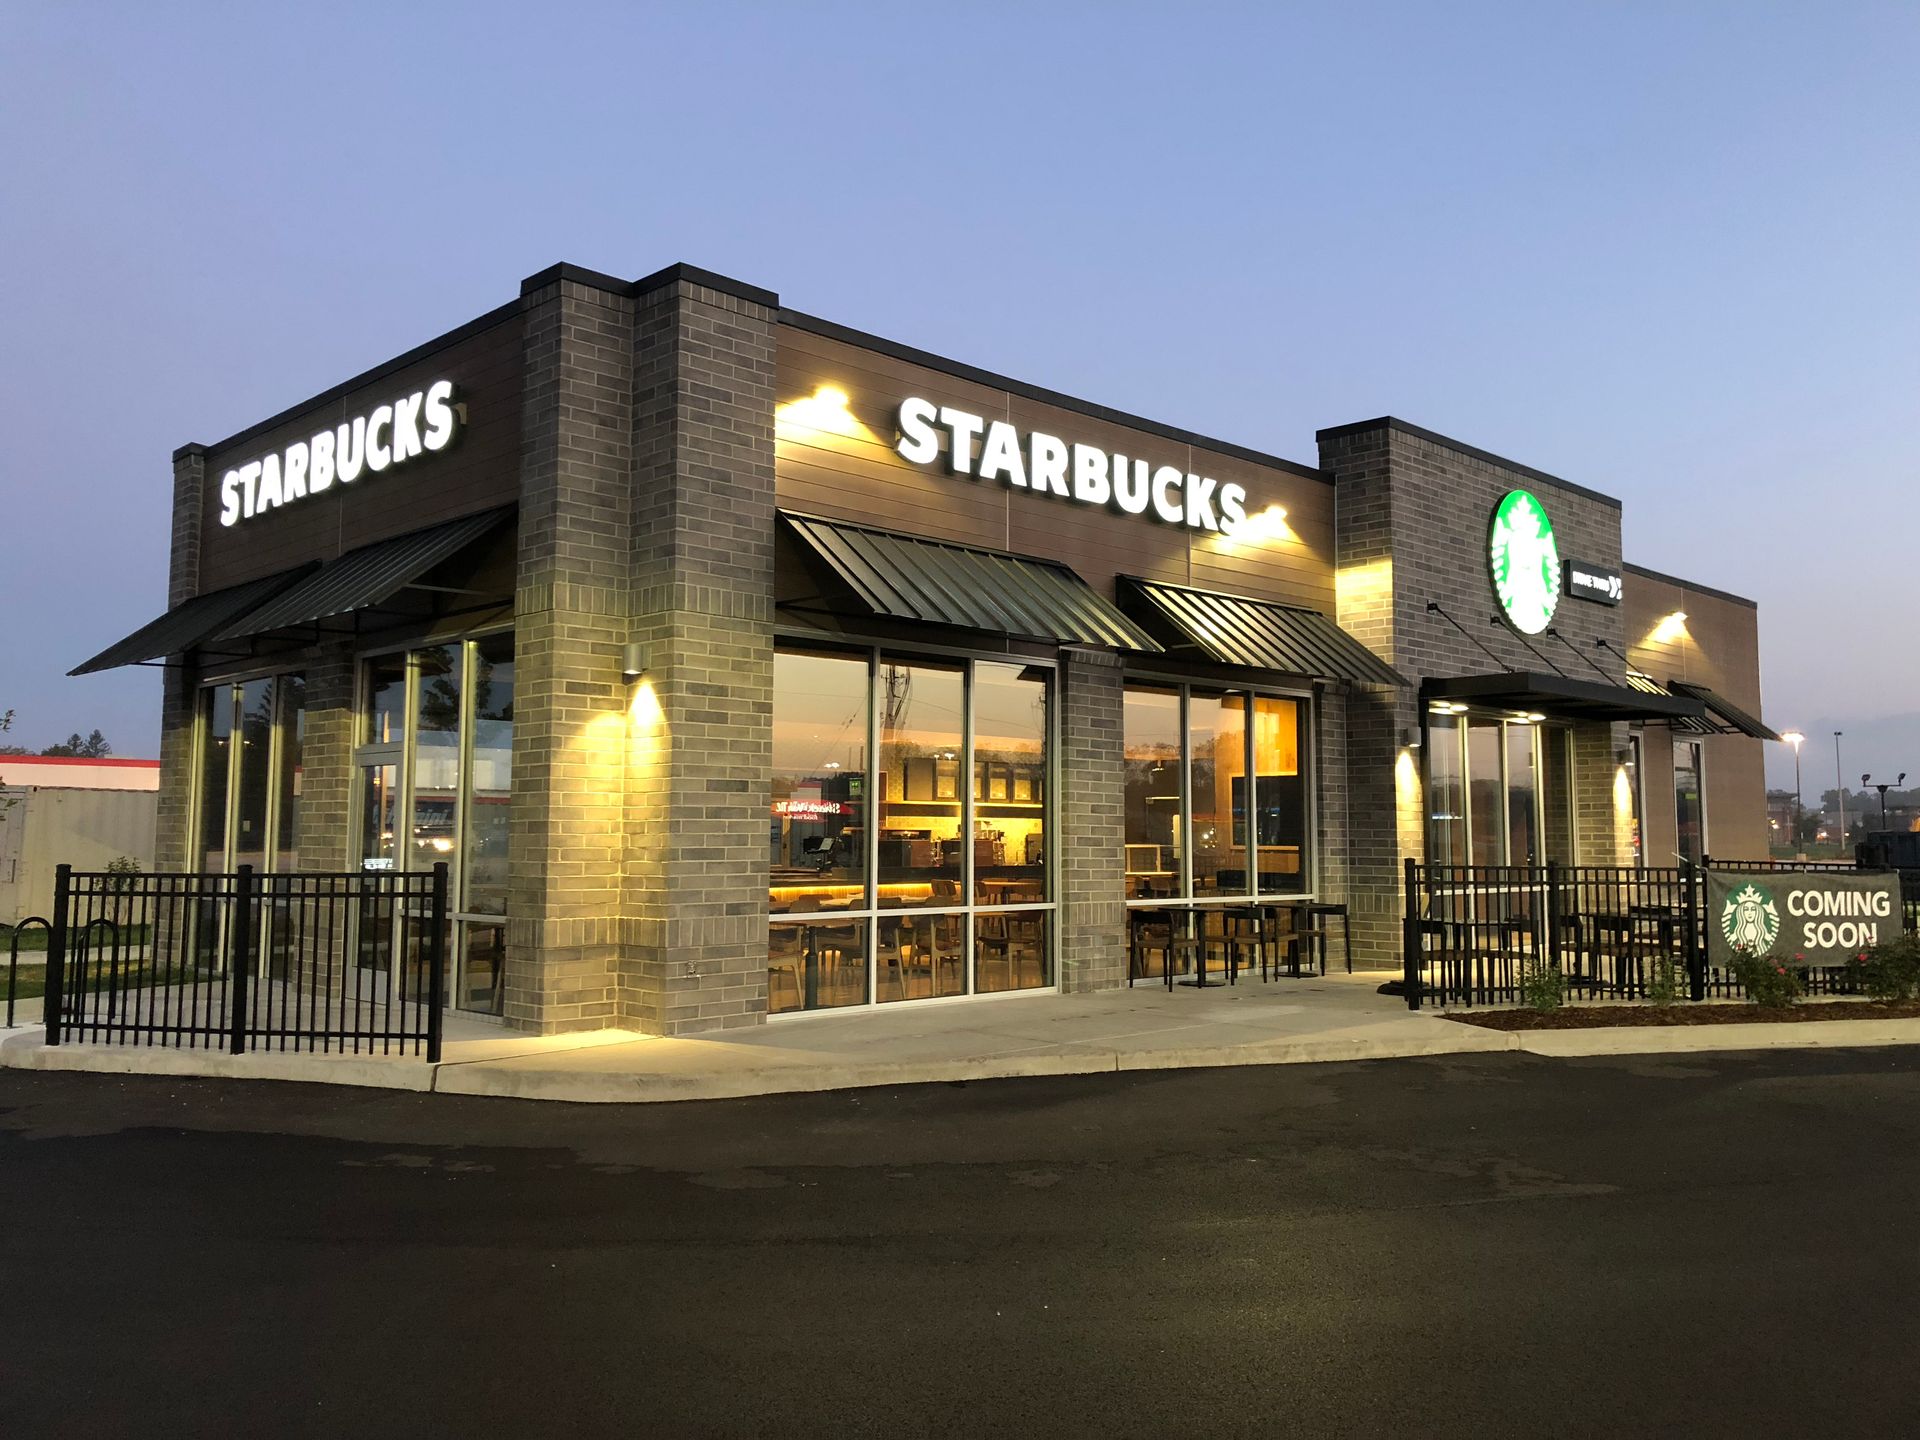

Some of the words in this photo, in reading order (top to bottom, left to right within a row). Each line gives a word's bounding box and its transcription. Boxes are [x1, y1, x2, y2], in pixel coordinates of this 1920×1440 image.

[220, 380, 452, 526] STARBUCKS
[897, 397, 1246, 537] STARBUCKS
[1787, 890, 1890, 917] COMING
[1803, 922, 1877, 948] SOON
